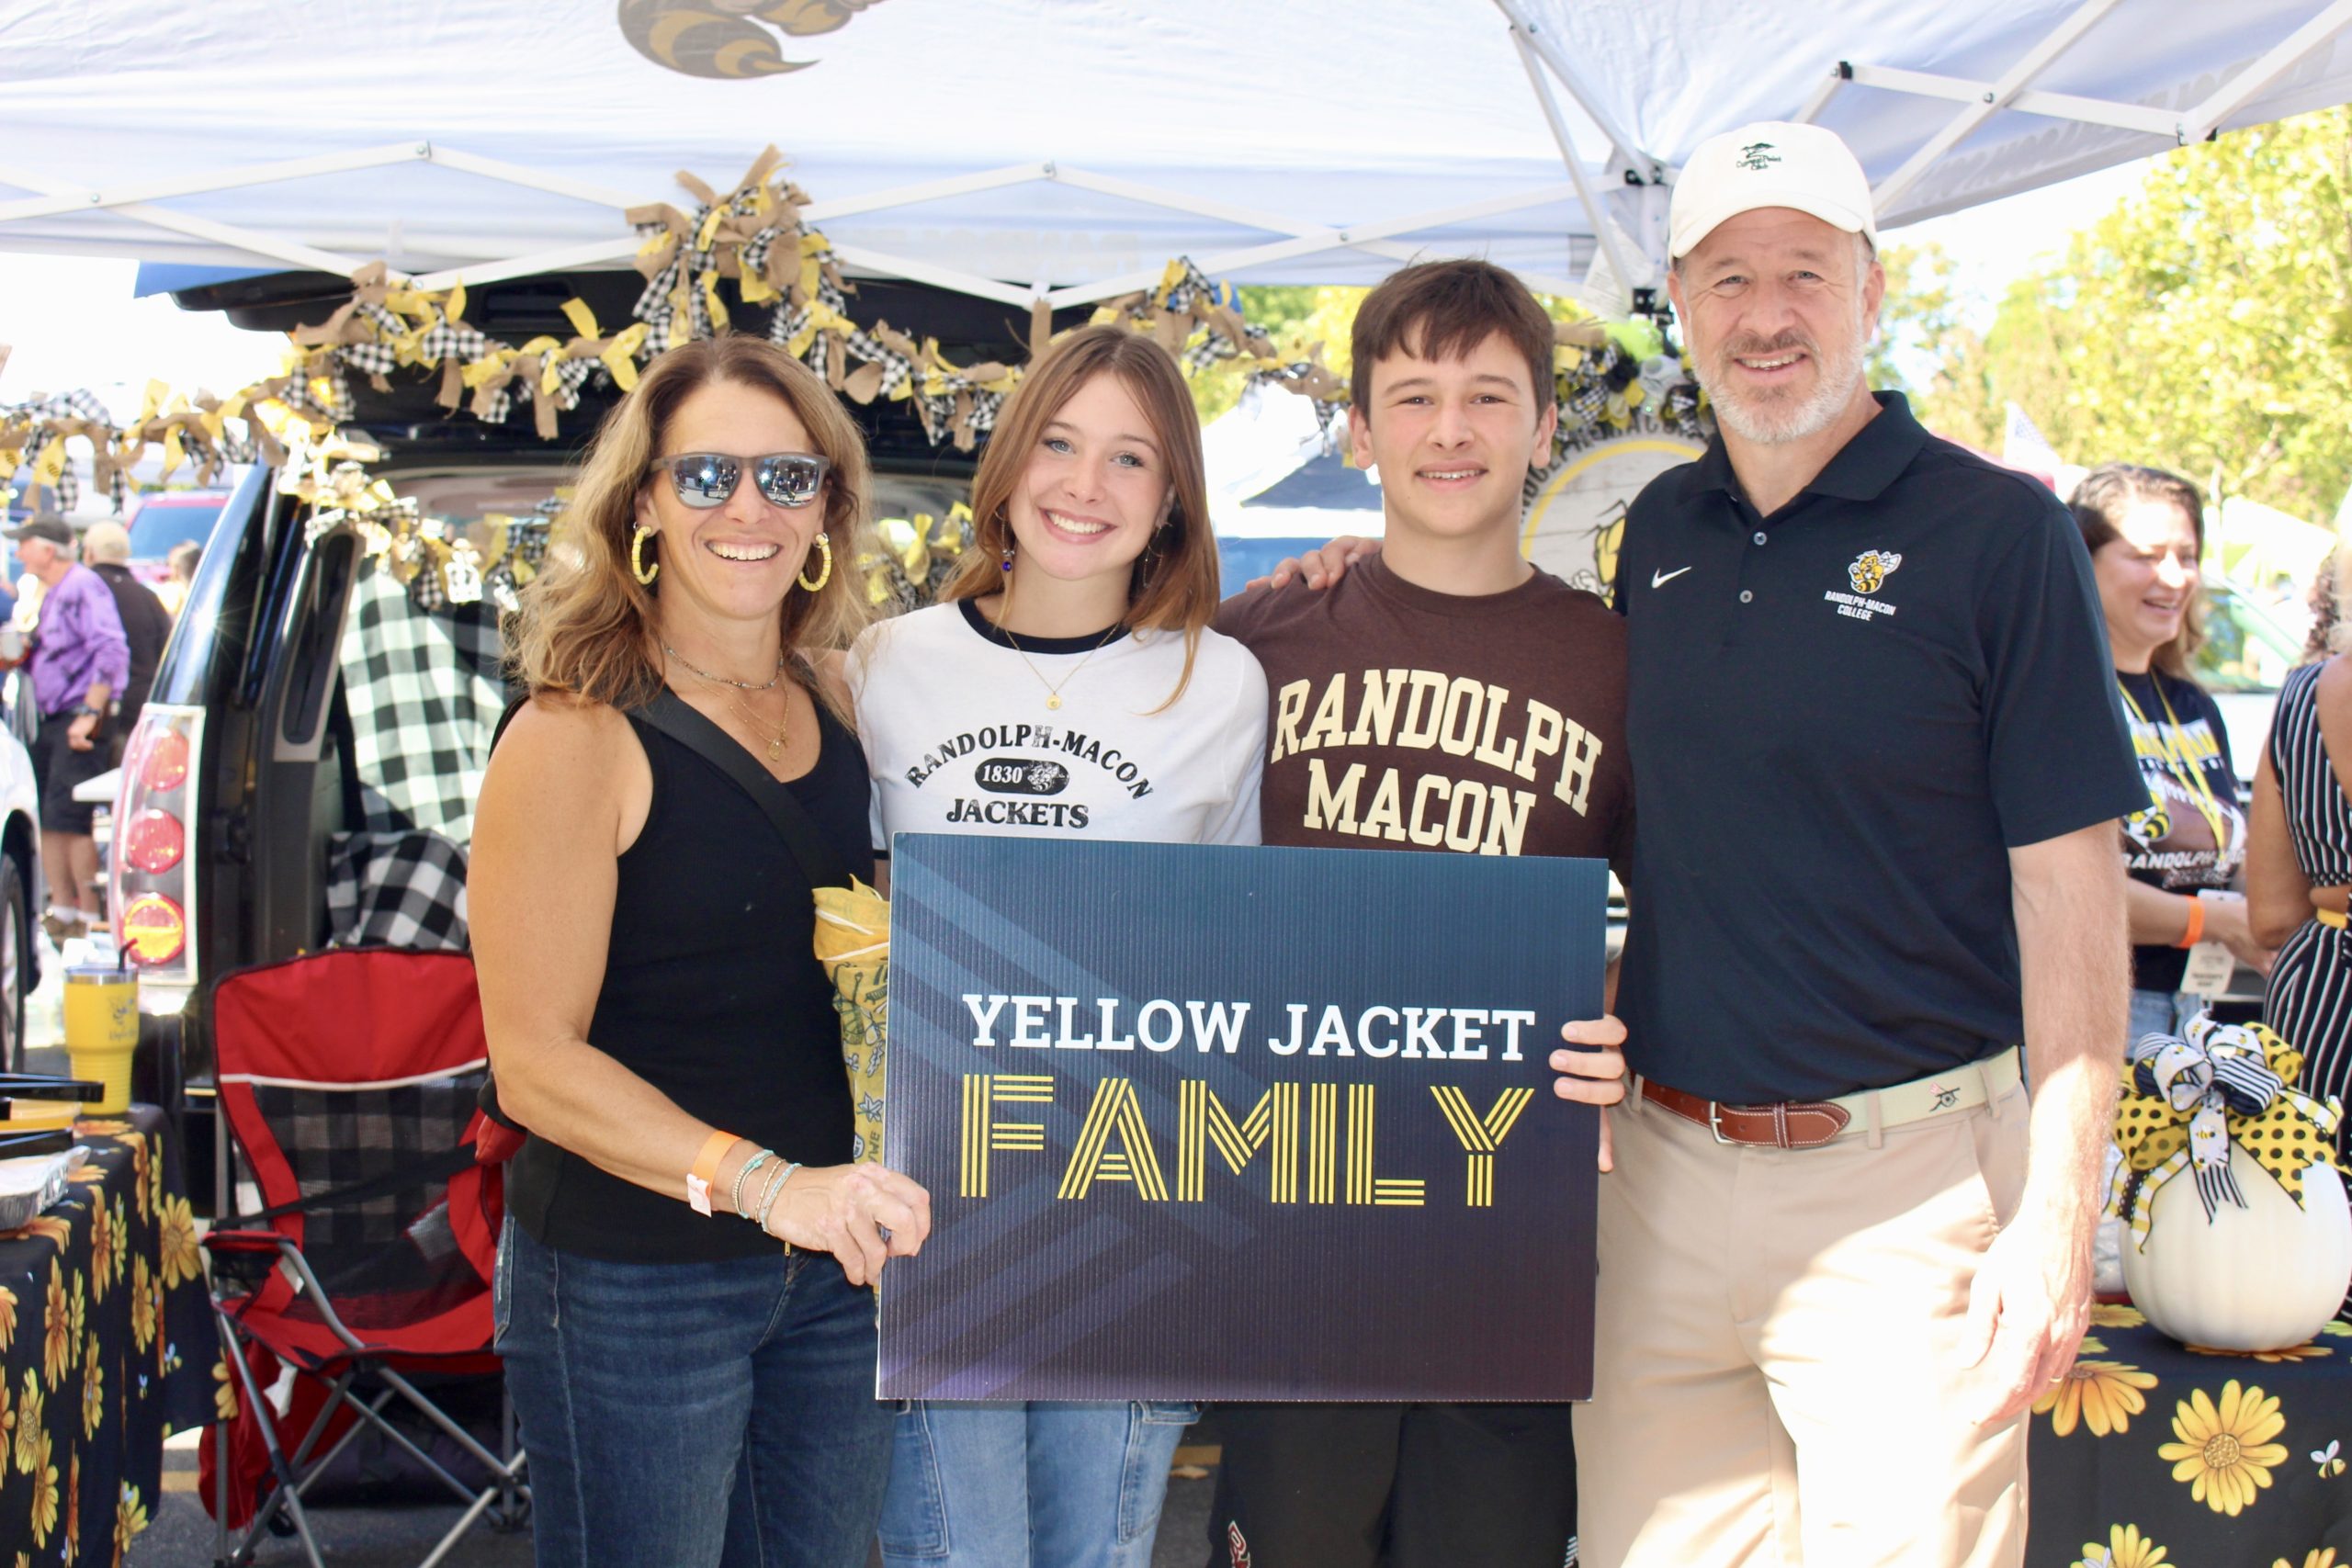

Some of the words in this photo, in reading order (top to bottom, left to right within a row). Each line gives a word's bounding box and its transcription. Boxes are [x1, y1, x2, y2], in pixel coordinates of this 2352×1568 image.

[1824, 591, 1896, 616] RANDOLPH-MACON
[1837, 604, 1872, 621] COLLEGE
[905, 724, 1153, 800] RANDOLPH-MACON
[982, 764, 1023, 784] 1830
[1271, 668, 1603, 818] RANDOLPH
[946, 798, 1089, 829] JACKETS
[1304, 759, 1536, 856] MACON
[962, 994, 1251, 1054] YELLOW
[1268, 1004, 1535, 1061] JACKET
[960, 1074, 1534, 1207] FAMILY
